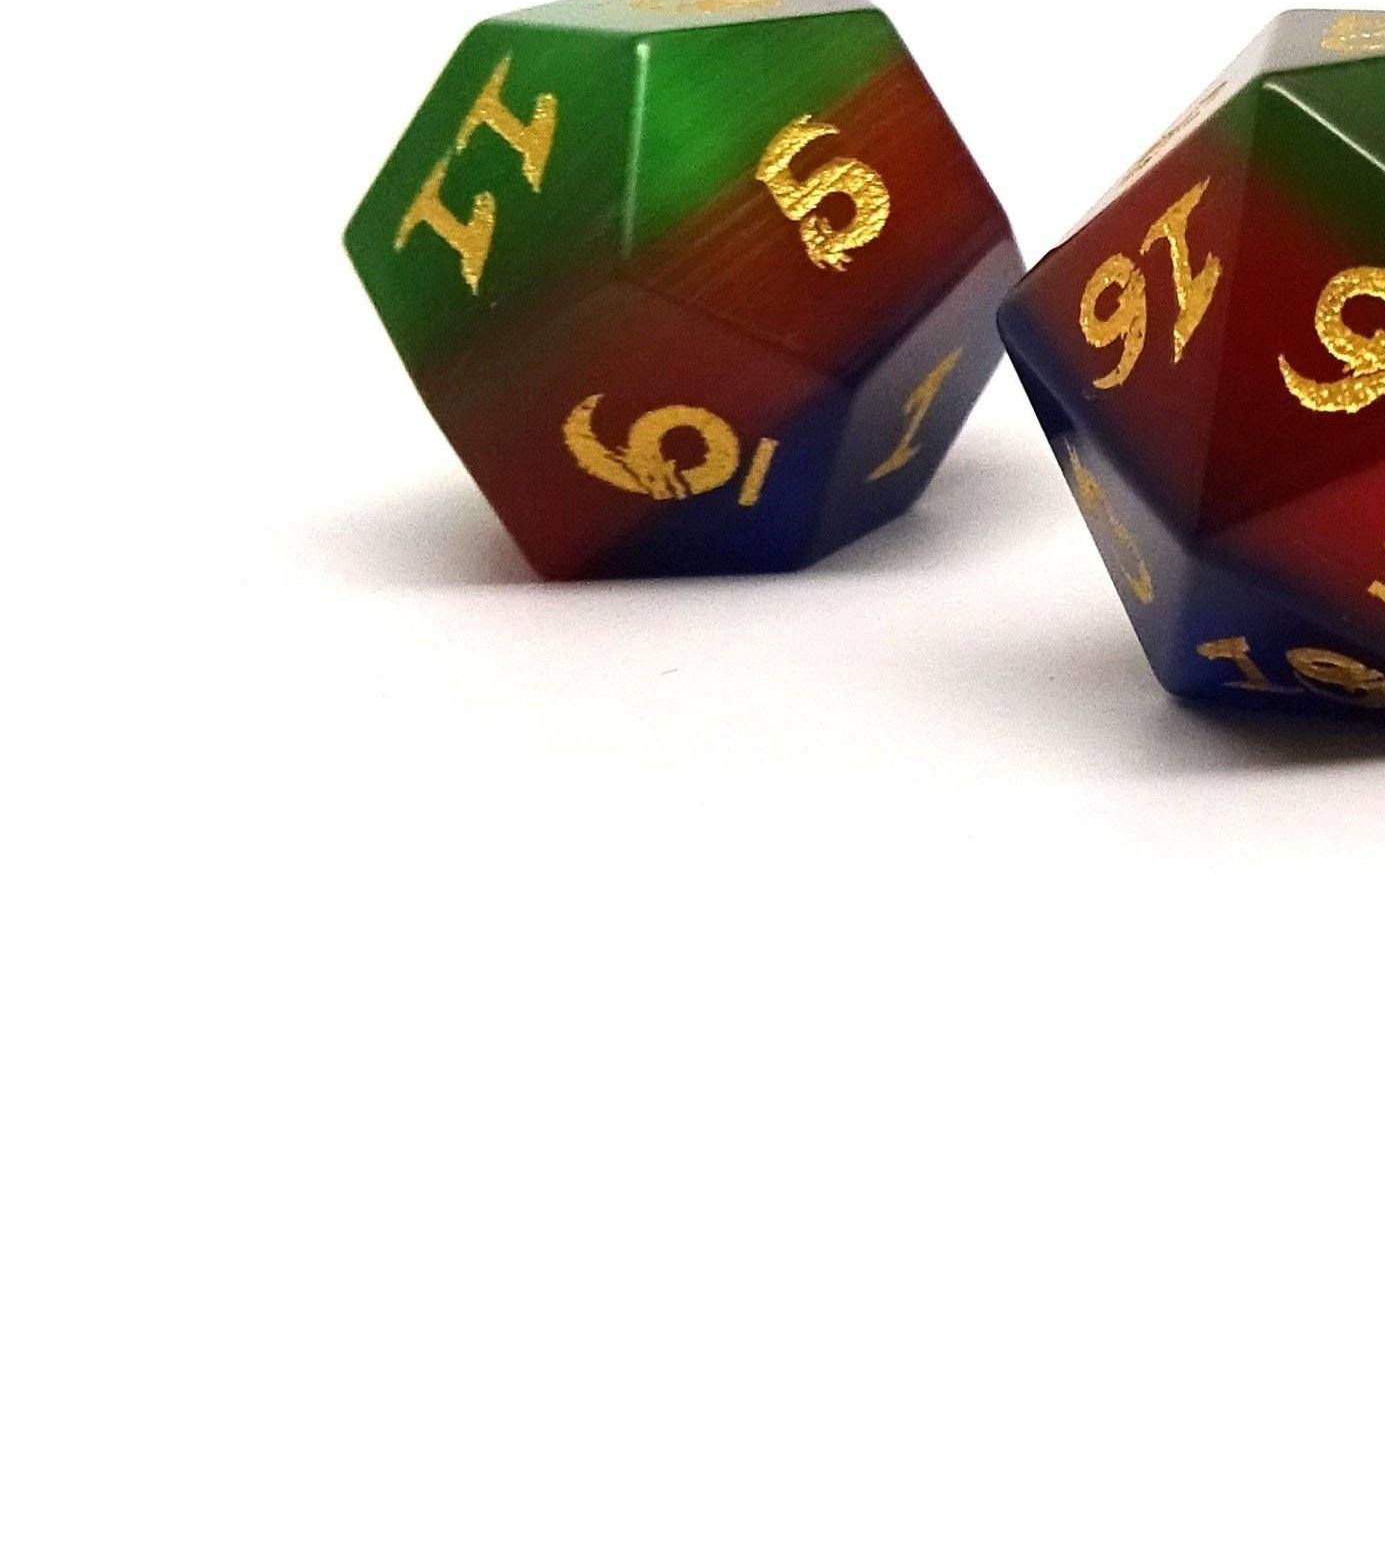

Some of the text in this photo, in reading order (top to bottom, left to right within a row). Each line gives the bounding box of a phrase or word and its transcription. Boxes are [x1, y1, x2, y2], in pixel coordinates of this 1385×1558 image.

[394, 47, 558, 296] 11
[754, 113, 892, 272] 5
[1079, 177, 1223, 391] 16
